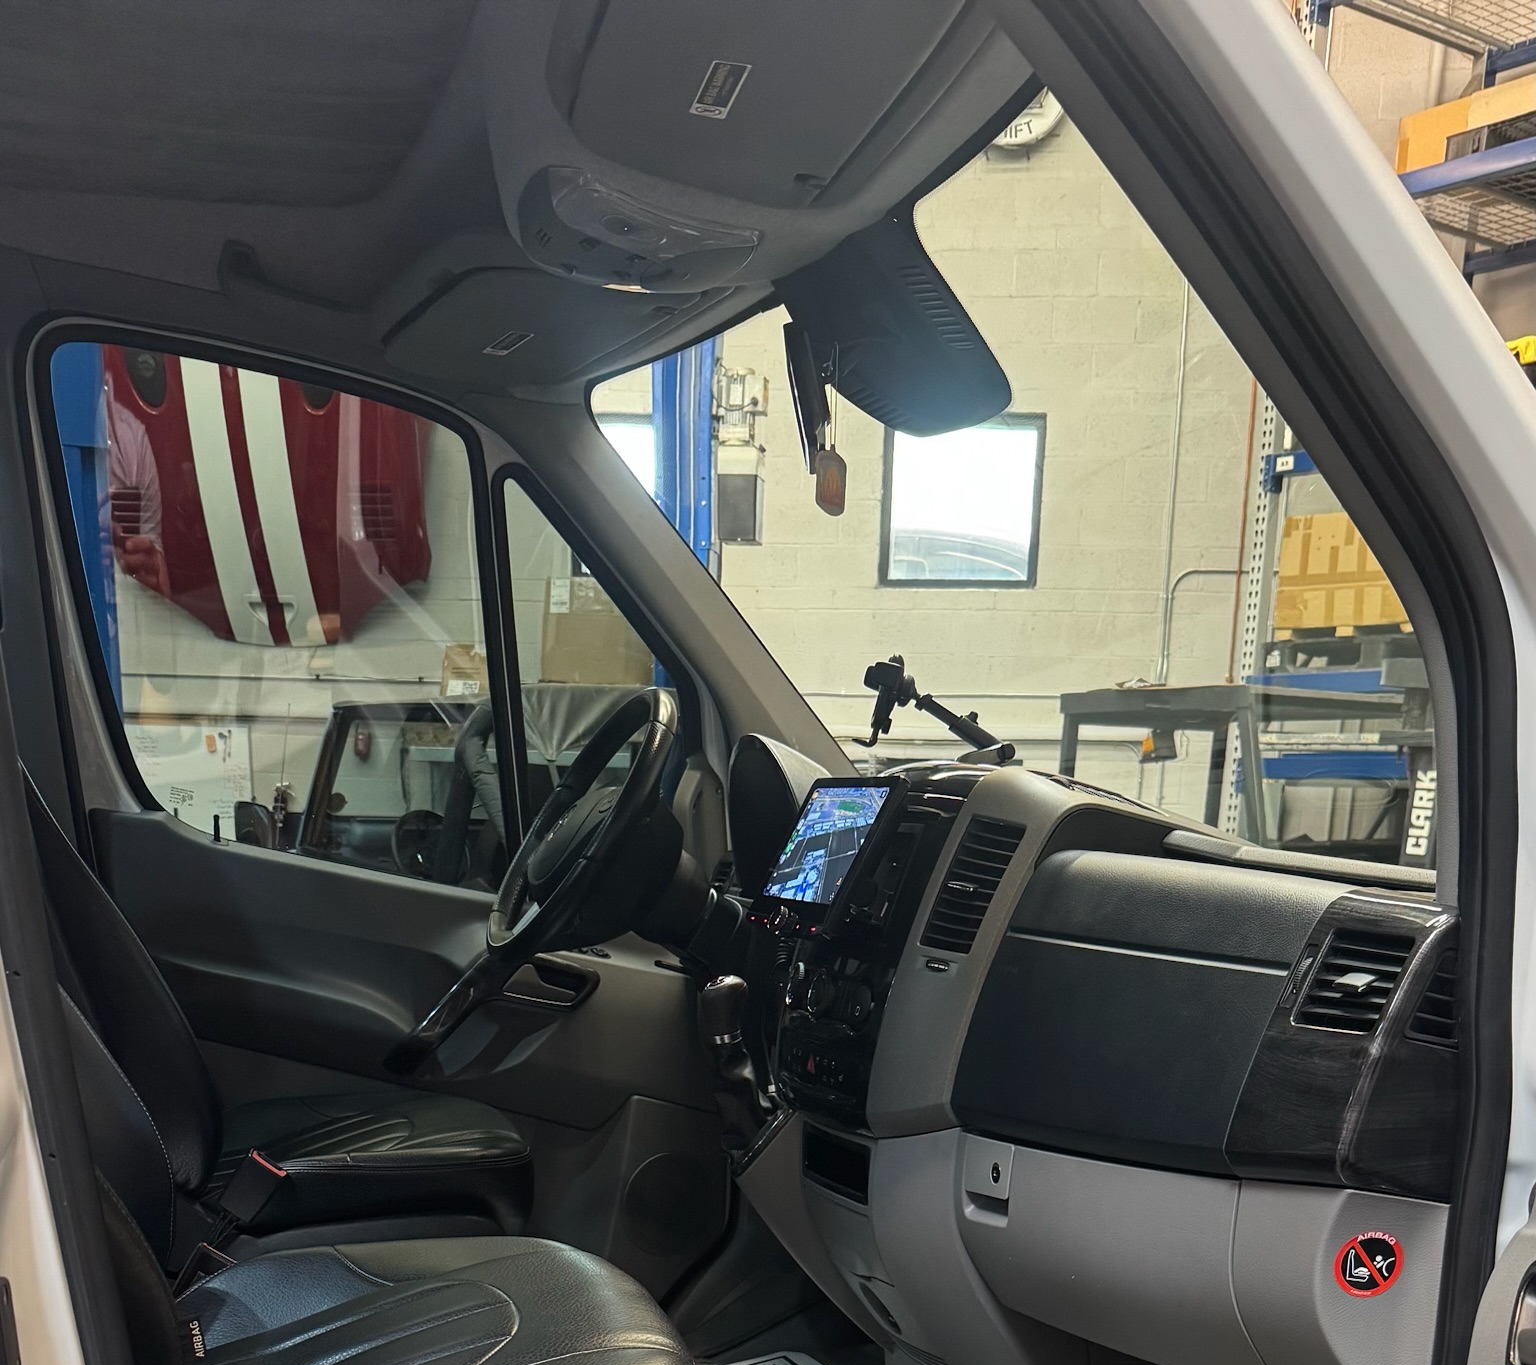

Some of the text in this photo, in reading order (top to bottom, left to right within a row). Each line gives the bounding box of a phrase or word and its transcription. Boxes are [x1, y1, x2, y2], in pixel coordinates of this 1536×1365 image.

[1405, 770, 1437, 856] CLARK
[1356, 1231, 1396, 1246] AIRBAG
[189, 1320, 205, 1358] AIRBAG
